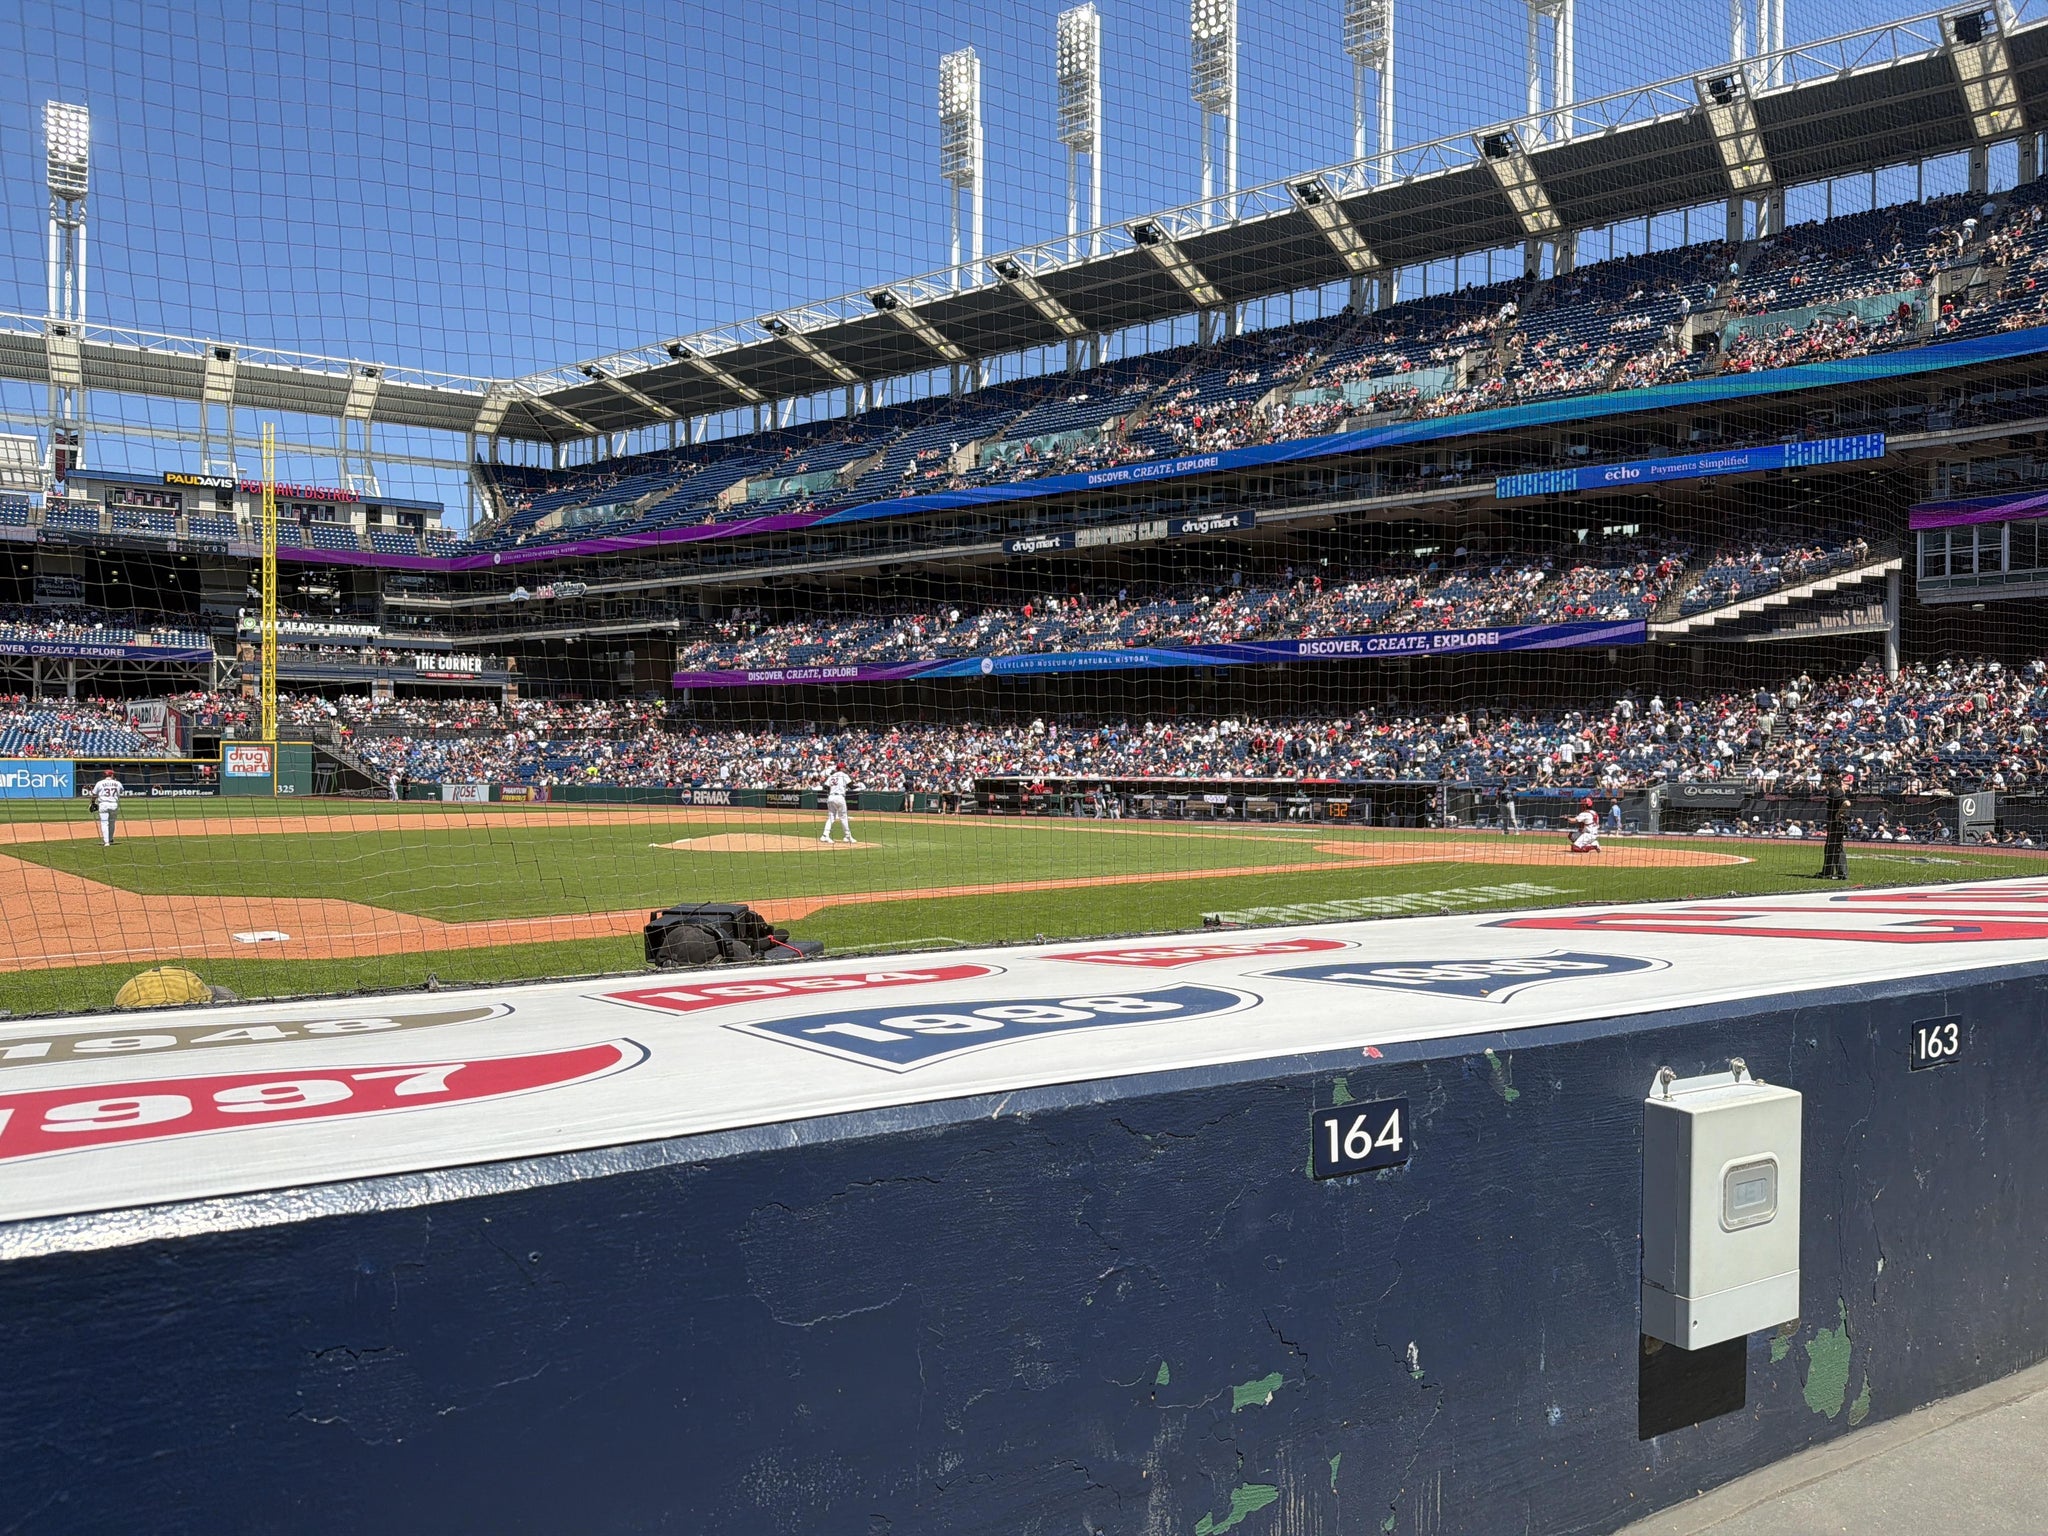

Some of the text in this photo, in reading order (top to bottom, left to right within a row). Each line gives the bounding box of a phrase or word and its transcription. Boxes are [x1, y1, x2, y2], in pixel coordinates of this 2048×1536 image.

[1088, 471, 1131, 485] DISCOVER,
[1133, 464, 1174, 478] CREATE,
[1604, 456, 1748, 481] echo Payments Simplified
[304, 485, 362, 502] DISTRICT
[1182, 515, 1239, 533] drug mart
[1012, 537, 1060, 553] drug mart
[330, 624, 381, 633] BREWERY
[31, 645, 78, 656] CREATE,
[1299, 640, 1363, 655] DISCOVER,
[1367, 636, 1430, 651] CREATE,
[415, 655, 482, 672] THE CORNER
[995, 655, 1149, 669] CLEVELAND MUSEUM of NATURAL HISTORY
[748, 671, 784, 682] DISCOVER,
[786, 668, 821, 680] CREATE,
[229, 747, 263, 763] drug
[233, 762, 270, 772] mart
[104, 788, 117, 797] 37
[152, 788, 213, 797] Dumpsters.com
[277, 785, 295, 794] 325
[1697, 787, 1736, 795] LEXUS
[1075, 944, 1310, 963] 1995
[1322, 958, 1608, 985] 1999
[637, 971, 940, 1003] 1954
[801, 995, 1184, 1043] 1998
[0, 1017, 402, 1061] 1948
[1917, 1023, 1959, 1060] 163
[0, 1064, 467, 1134] 997
[1324, 1107, 1403, 1164] 164
